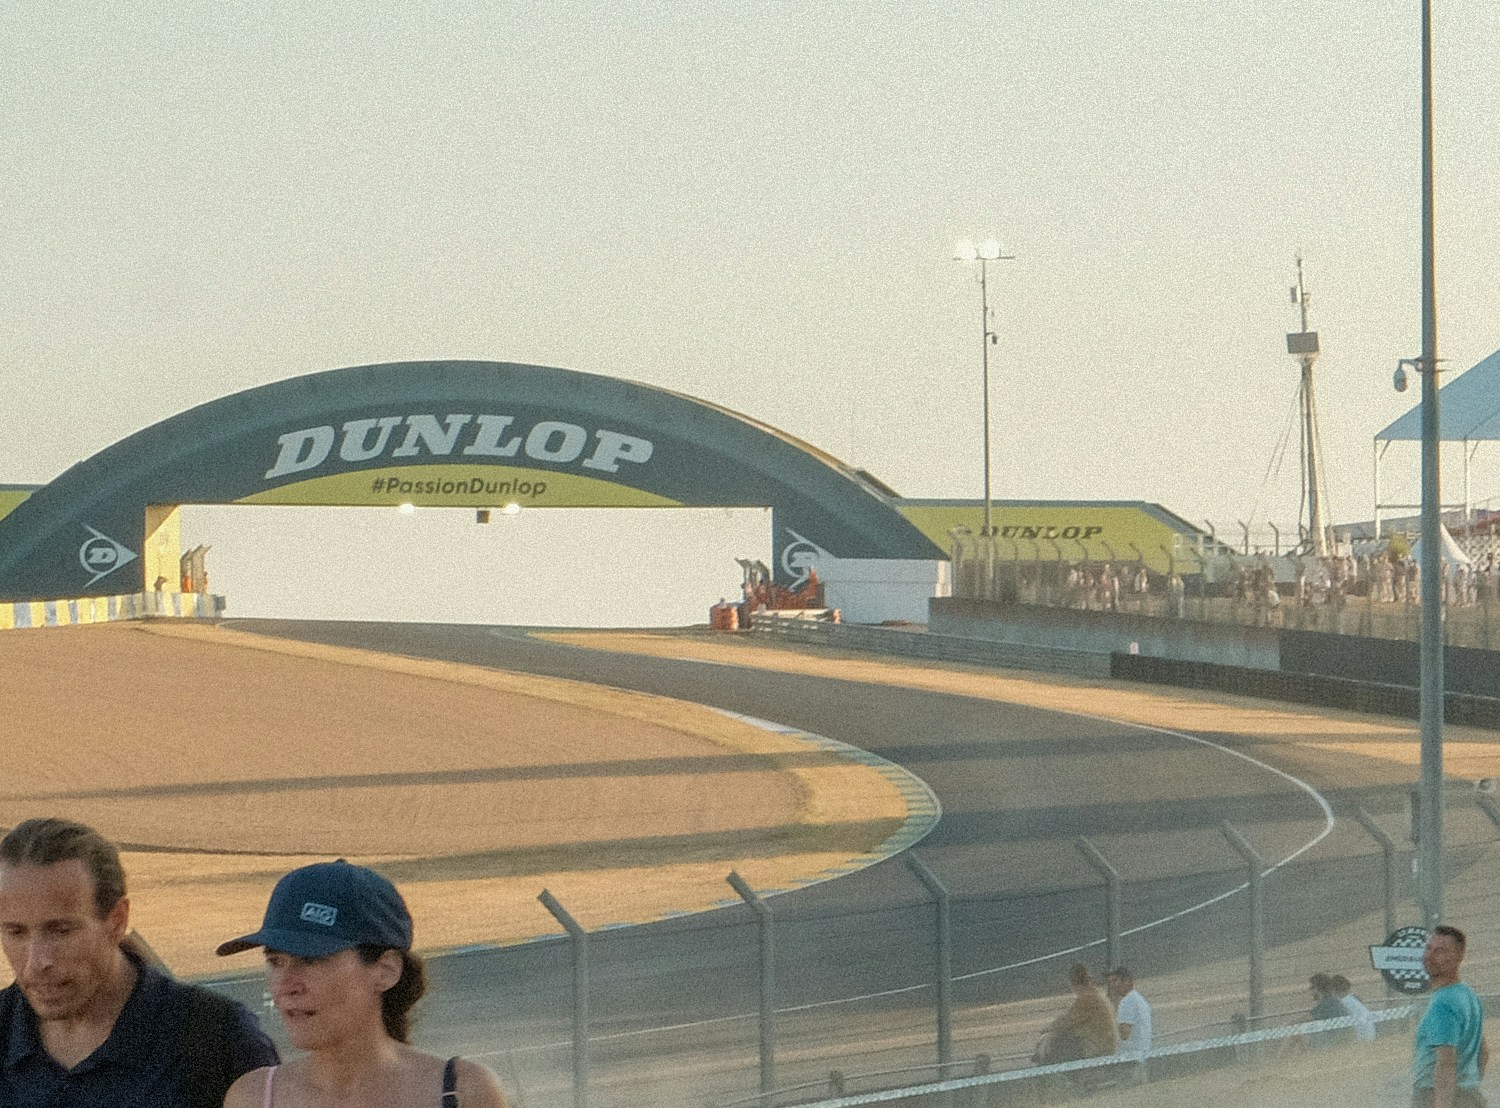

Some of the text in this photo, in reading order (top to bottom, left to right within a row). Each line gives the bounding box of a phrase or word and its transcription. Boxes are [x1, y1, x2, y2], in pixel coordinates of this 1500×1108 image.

[264, 413, 654, 480] DUNLOP
[371, 477, 547, 498] #PassionDunlop
[979, 525, 1103, 540] DUNLOP
